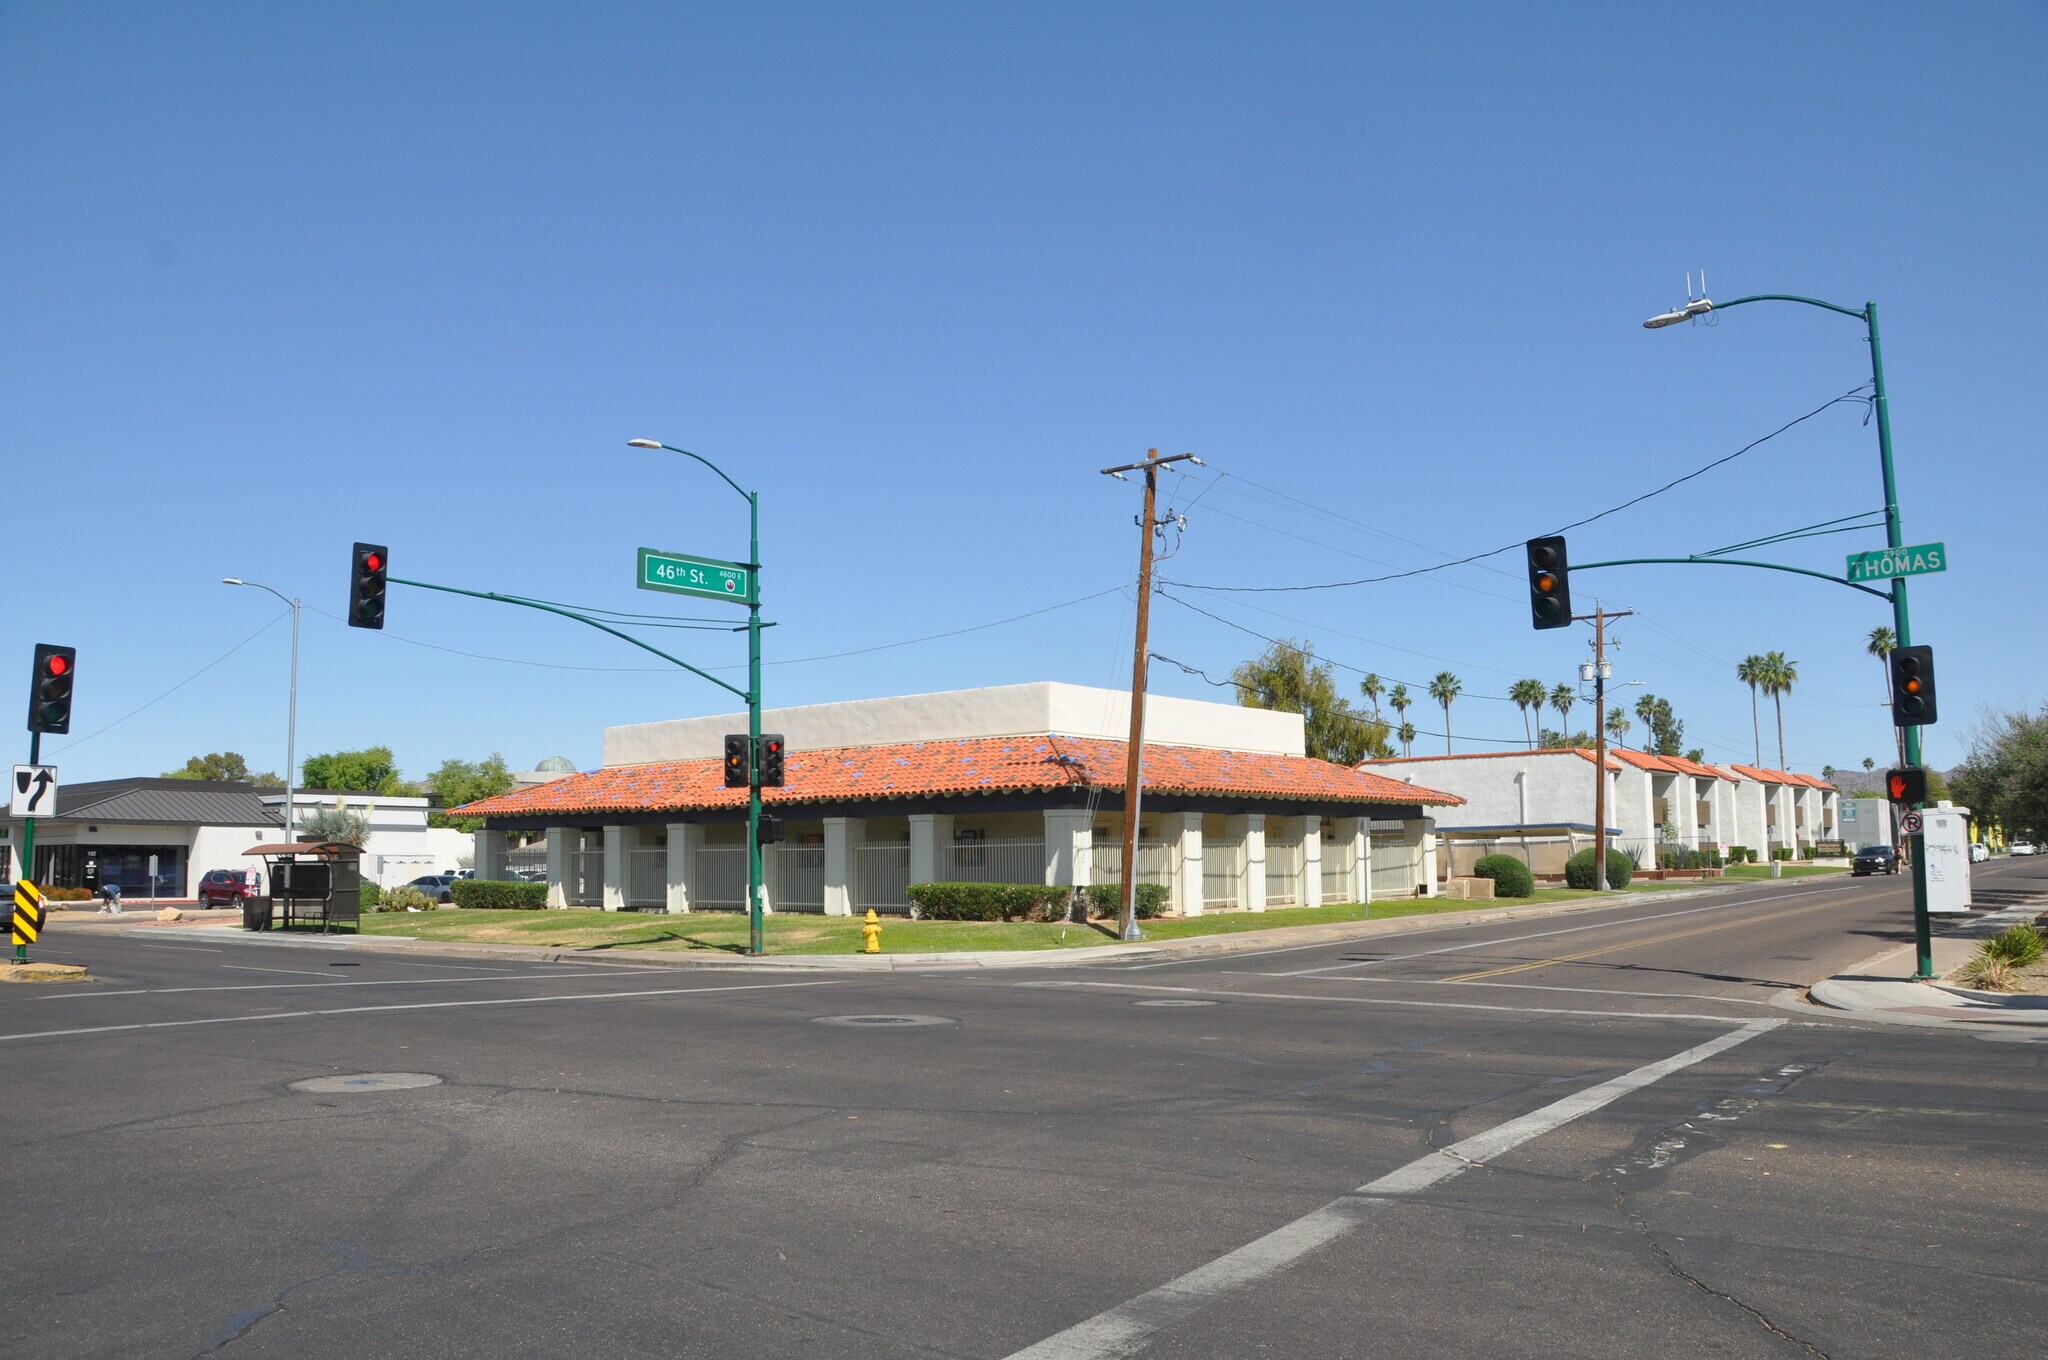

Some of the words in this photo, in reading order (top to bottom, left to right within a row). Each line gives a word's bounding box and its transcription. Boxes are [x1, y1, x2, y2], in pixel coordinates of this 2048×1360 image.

[1883, 548, 1908, 558] 2900
[1852, 551, 1941, 578] THOMAS
[656, 564, 686, 579] 46th
[689, 569, 708, 585] St.
[719, 570, 736, 579] 4600
[737, 572, 742, 580] E
